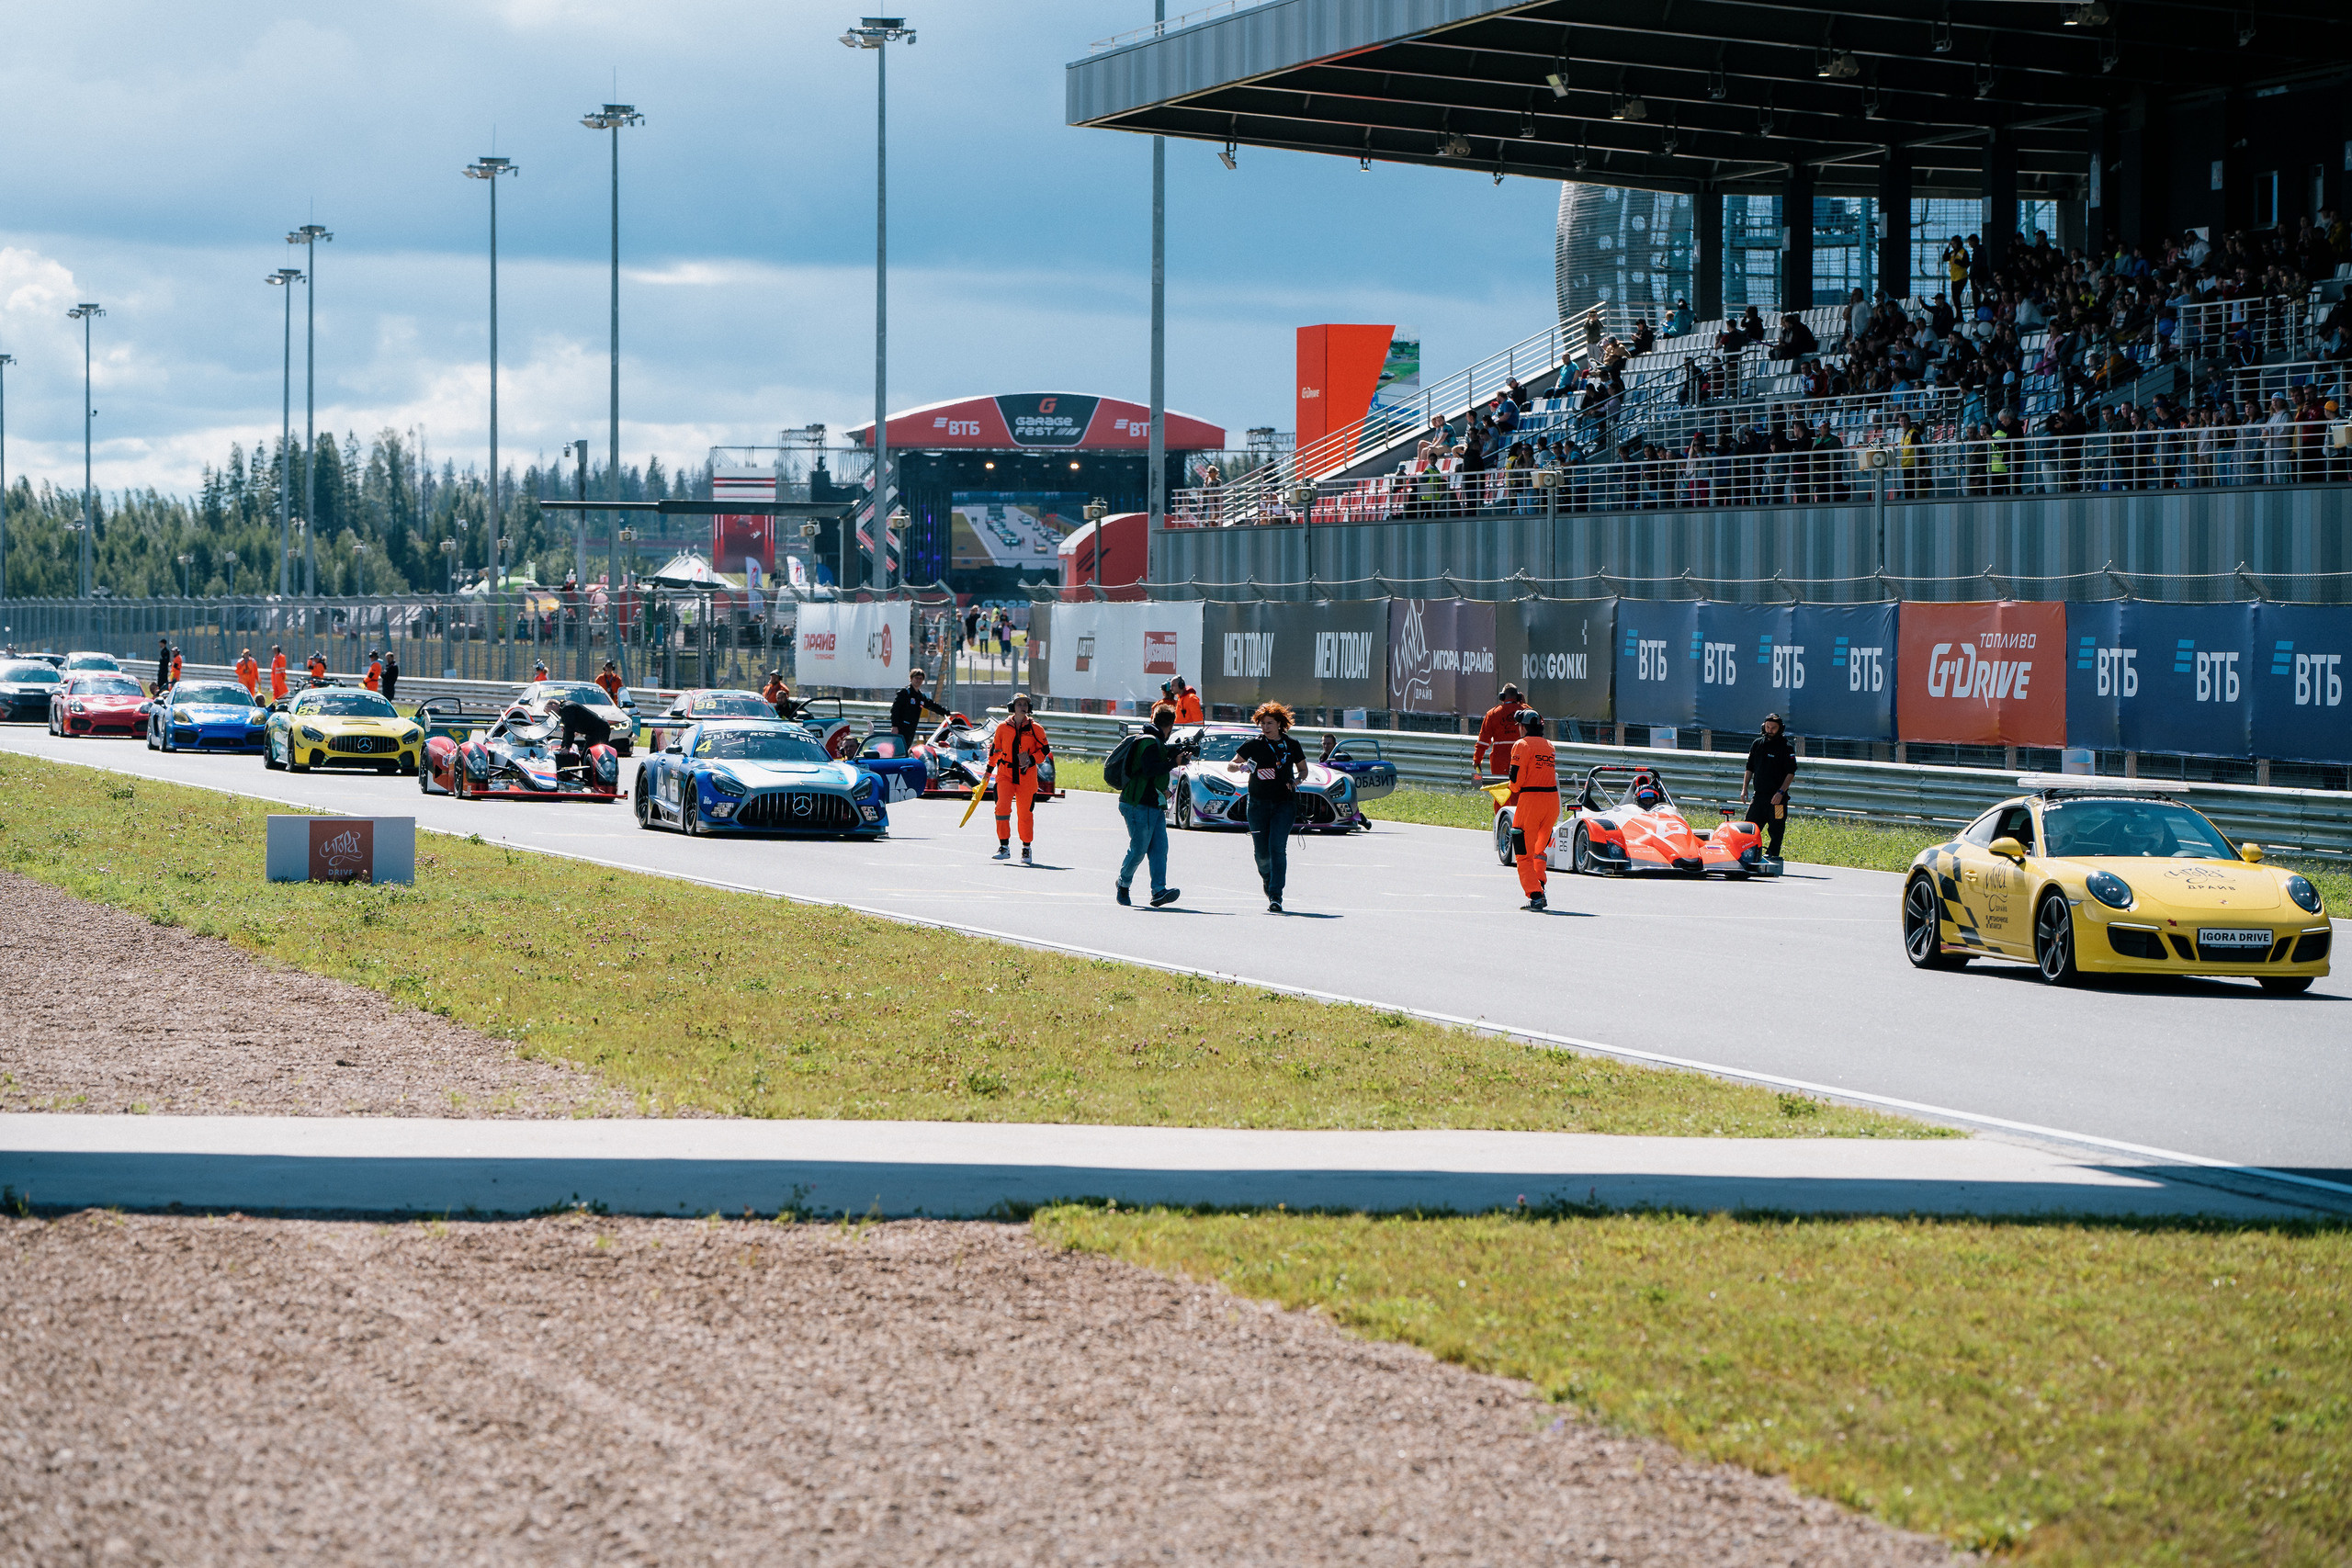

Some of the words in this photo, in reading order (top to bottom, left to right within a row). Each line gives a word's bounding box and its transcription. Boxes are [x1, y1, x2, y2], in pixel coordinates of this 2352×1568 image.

[948, 420, 980, 436] ВТБ
[1129, 422, 1151, 437] ВТ
[1223, 632, 1244, 677] MEN
[1244, 632, 1275, 678] TODAY
[1314, 632, 1339, 679] MEN
[1340, 631, 1374, 680] TODAY
[1980, 632, 2037, 649] ТОПЛИВО
[1433, 649, 1461, 671] ИГОРА
[1462, 646, 1494, 676] ДРАЙВ
[1521, 652, 1588, 680] ROSGONKI
[1638, 639, 1668, 682] ВТБ
[1703, 641, 1736, 685] ВТБ
[1772, 645, 1805, 689] ВТБ
[1849, 647, 1883, 693] ВТБ
[2097, 648, 2139, 697] ВТБ
[2196, 651, 2240, 703] ВТБ
[2294, 653, 2343, 706] ВТБ
[296, 705, 322, 716] 83
[694, 701, 717, 710] 98
[695, 739, 713, 753] 4
[1354, 774, 1396, 789] ОБАЗИТ
[2202, 932, 2236, 942] IGORA
[2239, 932, 2270, 942] DRIVE
